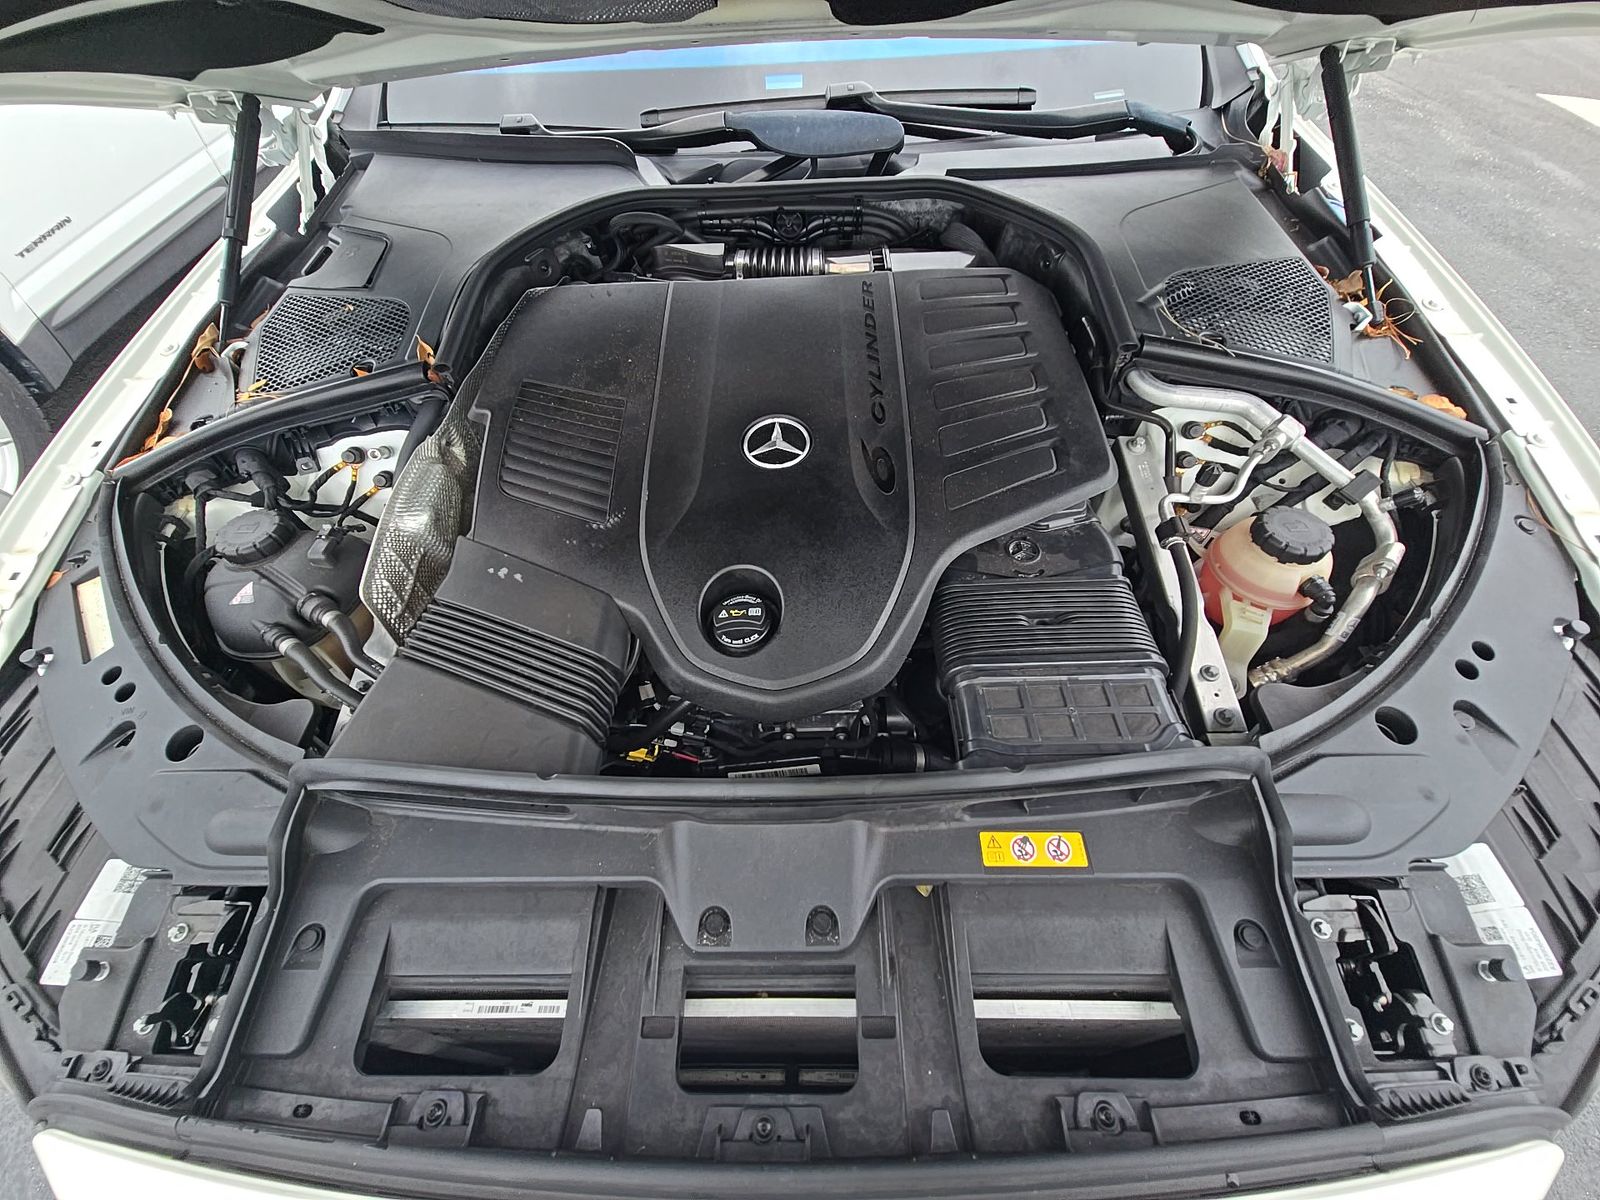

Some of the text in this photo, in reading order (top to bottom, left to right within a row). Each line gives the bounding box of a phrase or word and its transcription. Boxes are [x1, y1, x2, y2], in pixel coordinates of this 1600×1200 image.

[15, 216, 72, 258] TERRAIN
[860, 280, 895, 494] 6 CYLINDER
